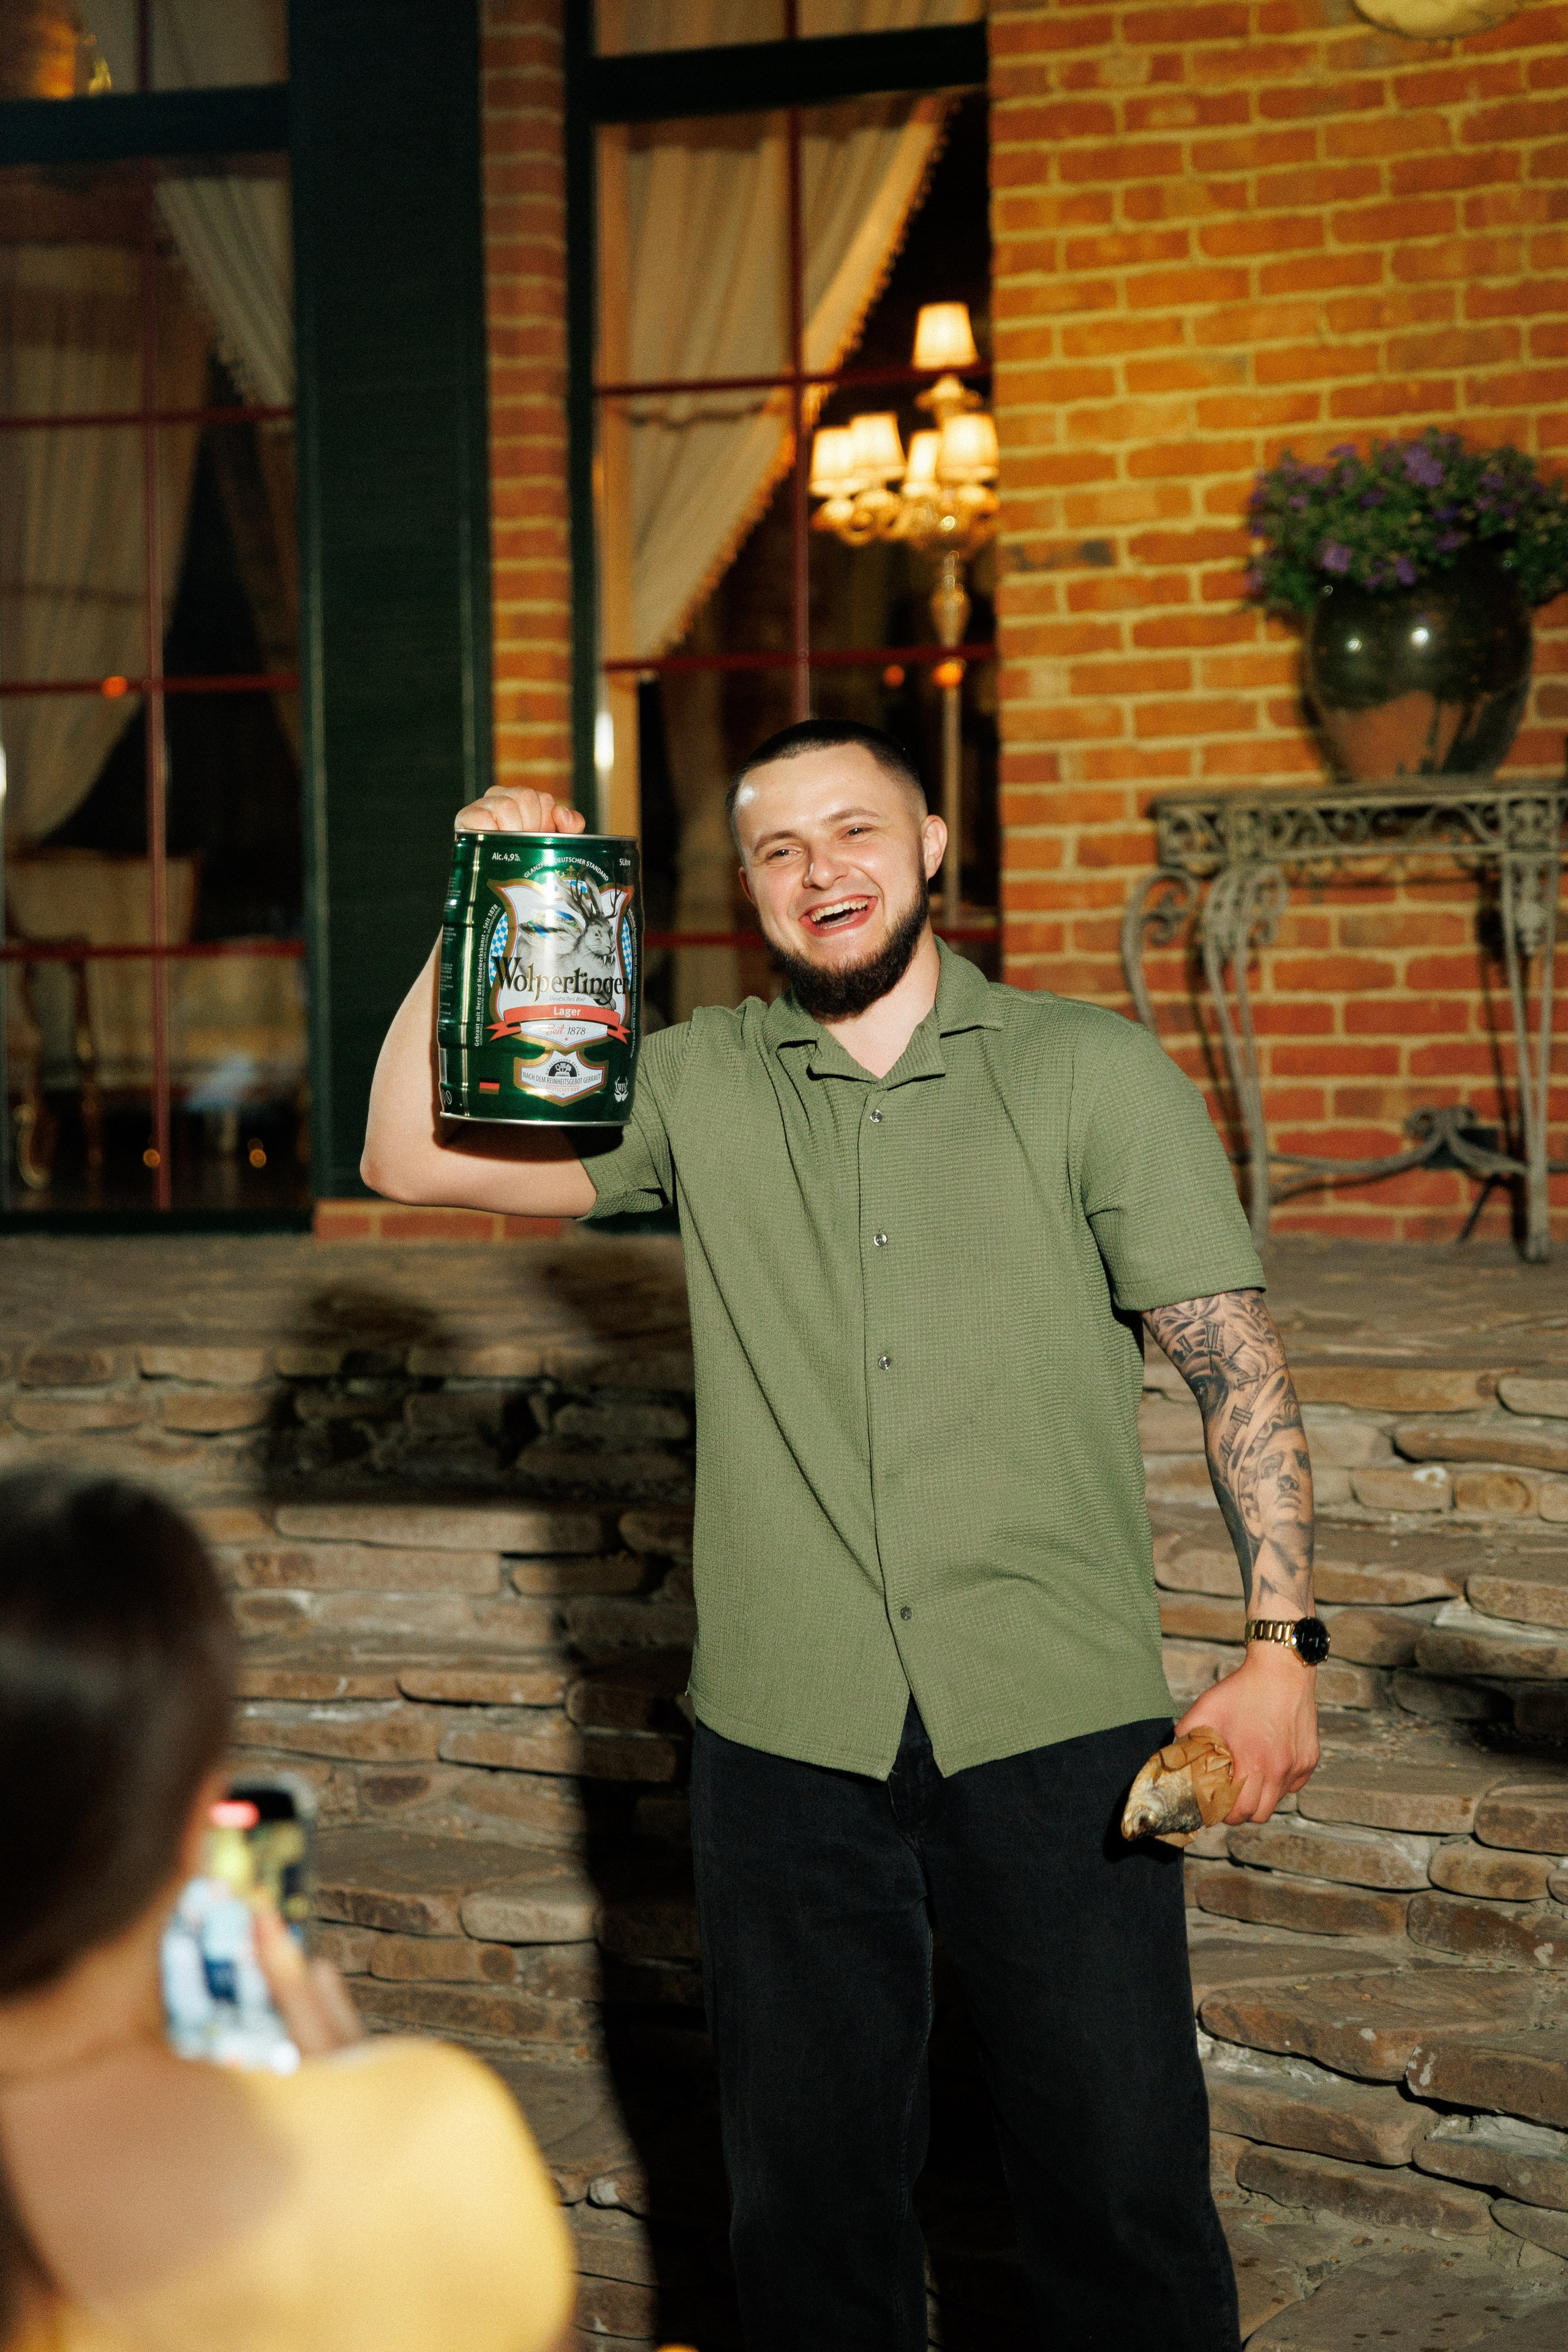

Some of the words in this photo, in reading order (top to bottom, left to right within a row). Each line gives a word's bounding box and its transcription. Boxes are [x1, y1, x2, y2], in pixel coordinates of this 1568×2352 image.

[554, 856, 586, 865] DEUTSCHER
[586, 861, 609, 881] STANDARD
[477, 934, 486, 982] Handwerkskunst
[488, 903, 499, 917] 1878
[491, 956, 628, 1005] Wolpertinger
[553, 1006, 581, 1018] Lager
[546, 1023, 565, 1035] Seit
[567, 1027, 586, 1035] 1878
[522, 1071, 535, 1081] NACH
[546, 1077, 583, 1085] REINHEITSGEBOT
[583, 1073, 601, 1084] GEBRAUT
